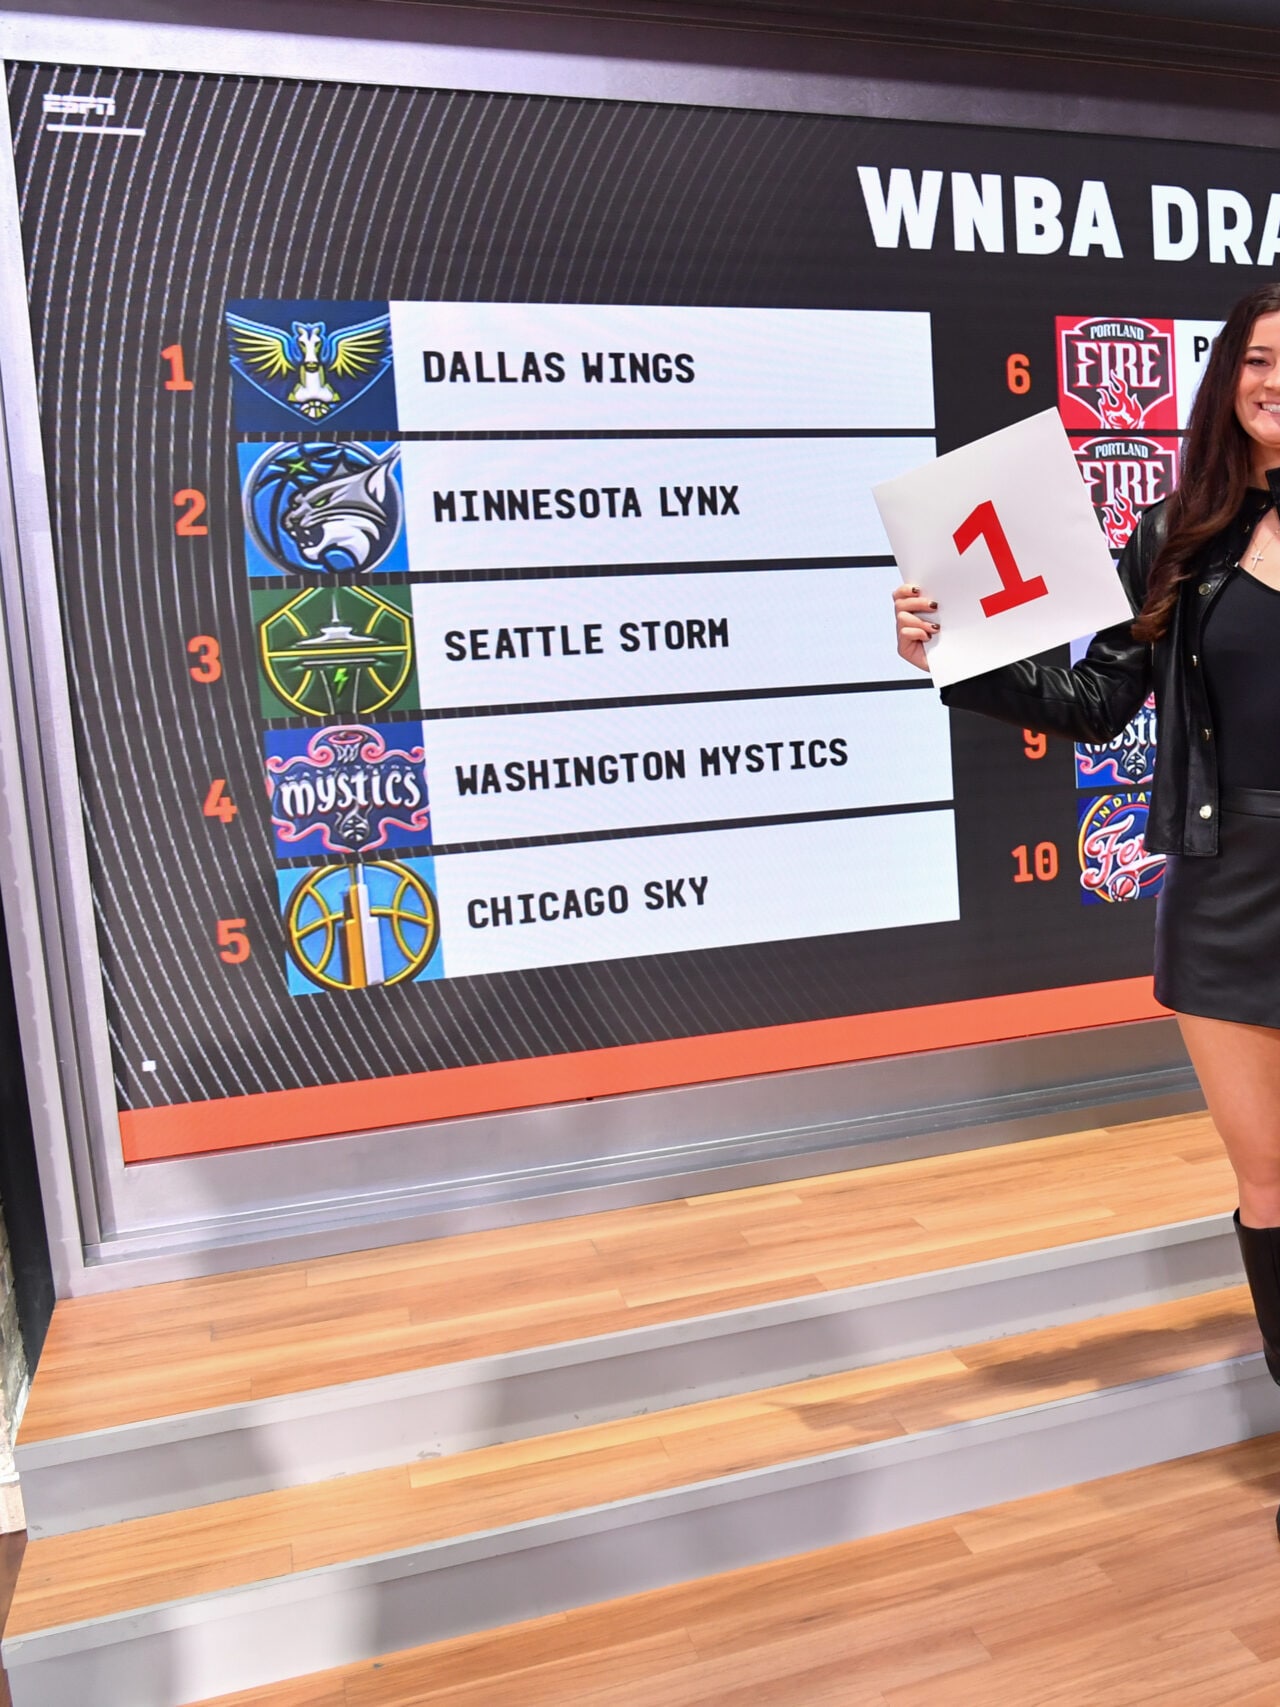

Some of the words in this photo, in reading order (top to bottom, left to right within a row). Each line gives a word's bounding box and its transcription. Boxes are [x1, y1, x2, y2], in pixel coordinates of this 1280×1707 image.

[43, 94, 116, 115] ESPN
[857, 166, 1124, 259] WNBA
[1090, 324, 1144, 341] PORTLAND
[161, 344, 194, 391] 1
[423, 350, 566, 383] DALLAS
[582, 352, 695, 384] WINGS
[1006, 353, 1032, 395] 6
[1073, 341, 1161, 388] FIRE
[1095, 442, 1149, 459] PORTLAND
[433, 487, 642, 522] MINNESOTA
[660, 485, 740, 517] LYNX
[1081, 460, 1166, 506] FIRE
[172, 488, 209, 537] 2
[952, 500, 1049, 618] 1
[187, 635, 222, 684] 3
[444, 623, 604, 661] SEATTLE
[620, 617, 729, 653] STORM
[455, 749, 686, 796] WASHINGTON
[700, 738, 848, 777] MYSTICS
[203, 779, 238, 823] 4
[1091, 792, 1148, 828] INDIA
[1011, 841, 1059, 883] 10
[467, 884, 629, 928] CHICAGO
[645, 876, 708, 910] SKY
[216, 918, 251, 964] 5
